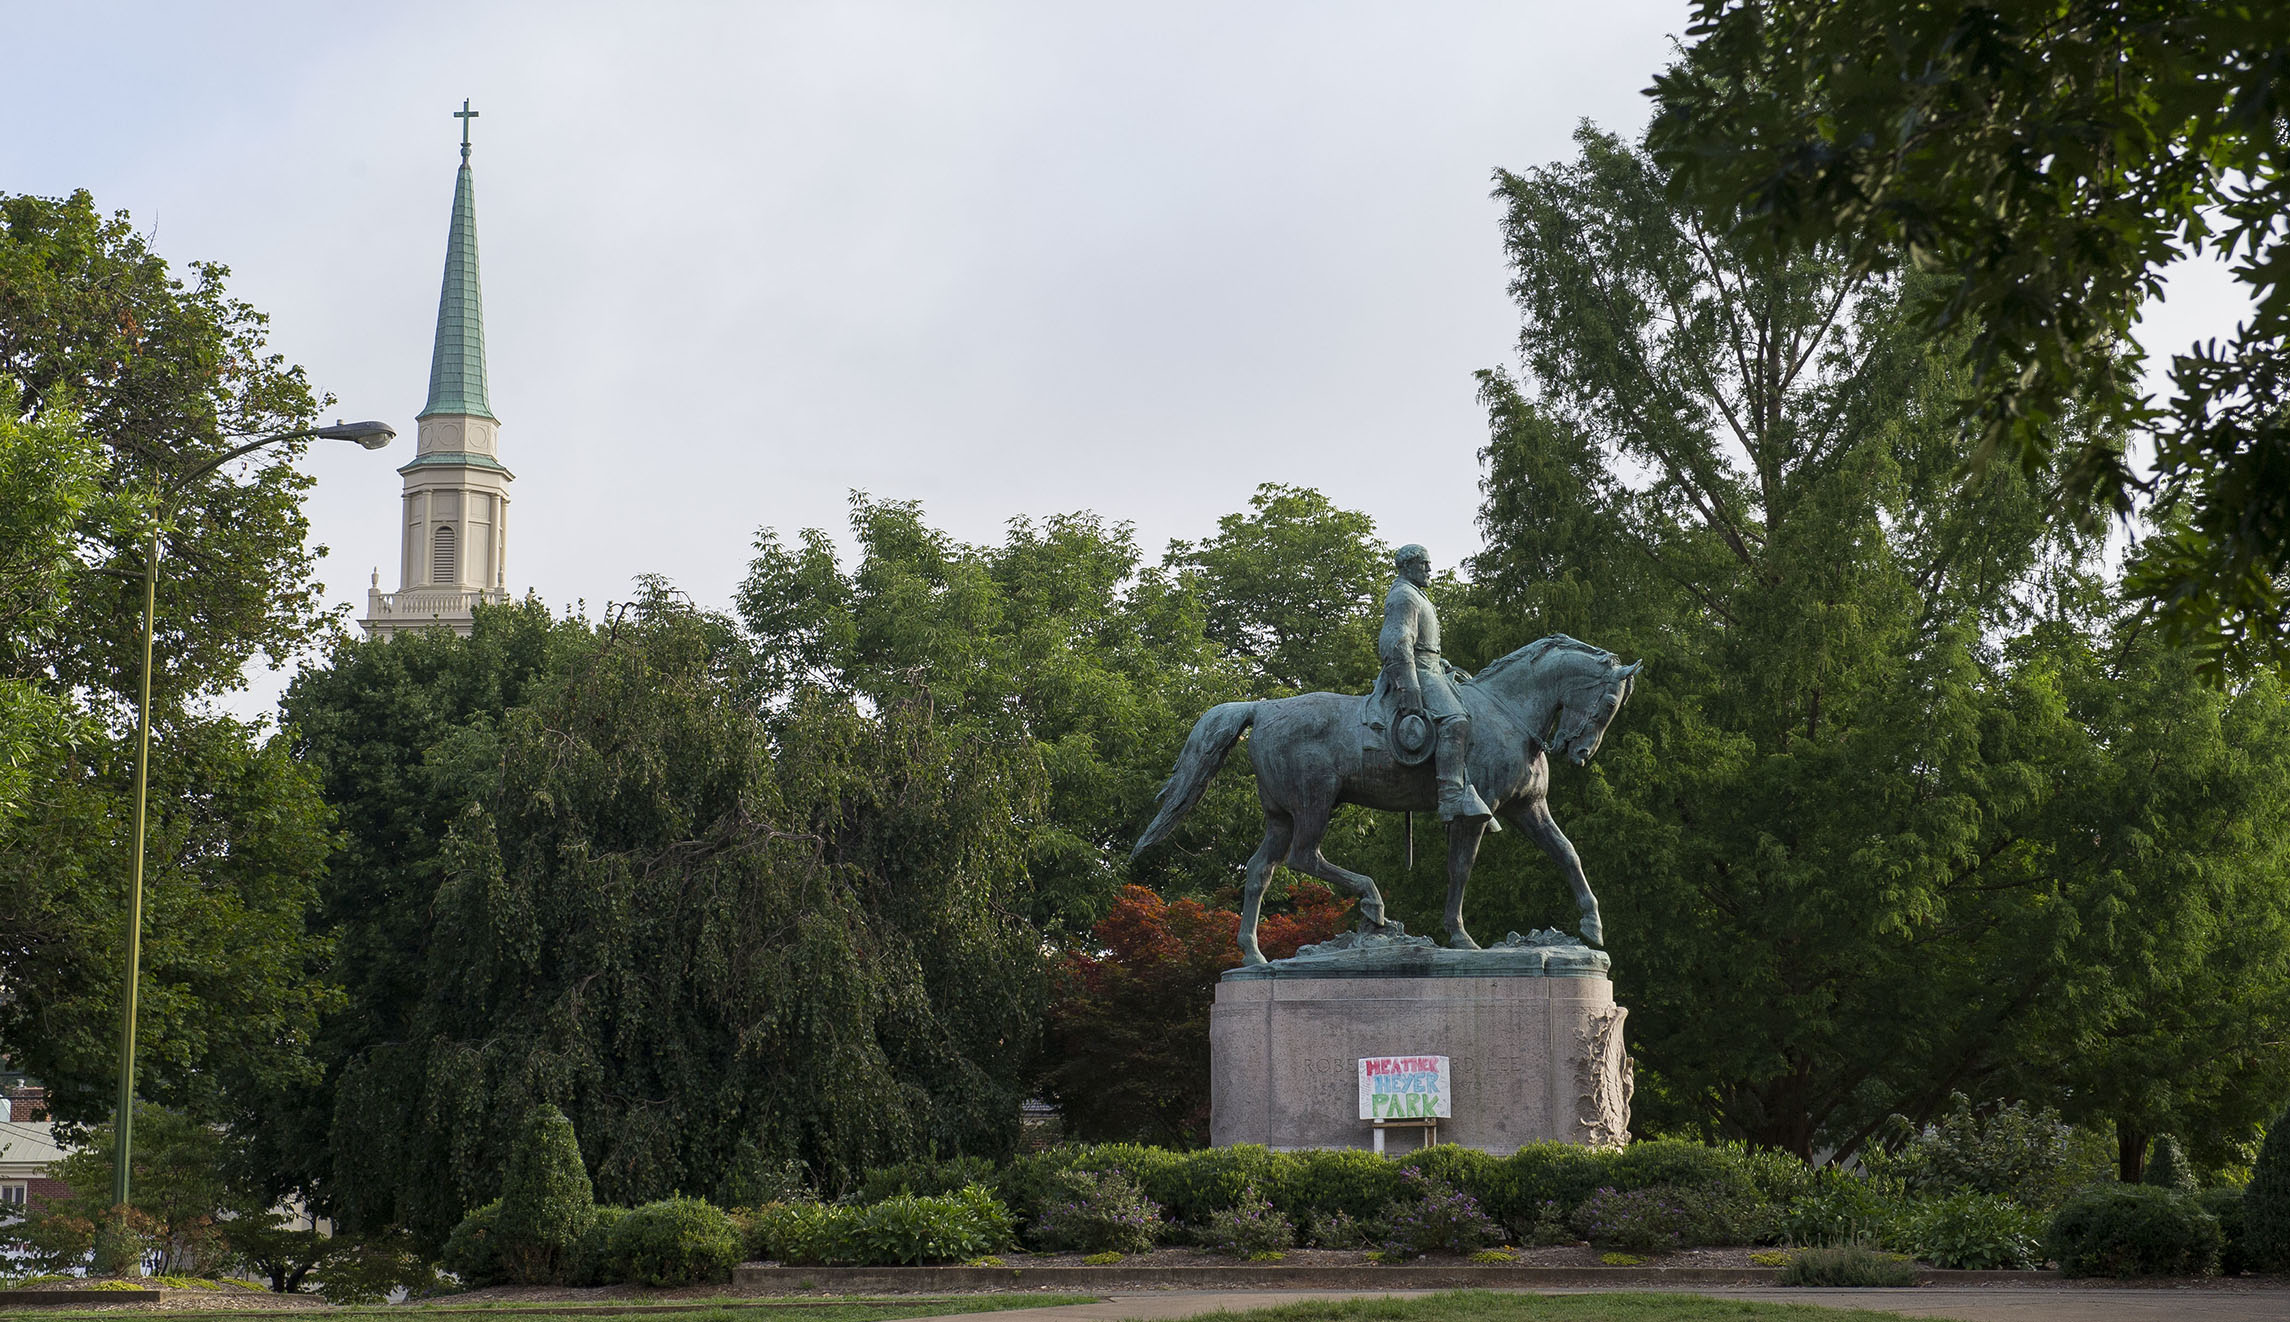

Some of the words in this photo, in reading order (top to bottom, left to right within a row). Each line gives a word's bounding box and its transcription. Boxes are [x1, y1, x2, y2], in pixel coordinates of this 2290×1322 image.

[1304, 1058, 1357, 1073] ROBE
[1487, 1056, 1521, 1072] LEE
[1365, 1057, 1439, 1076] HEATHER
[1373, 1073, 1440, 1094] HEYER
[1371, 1093, 1440, 1118] PARK
